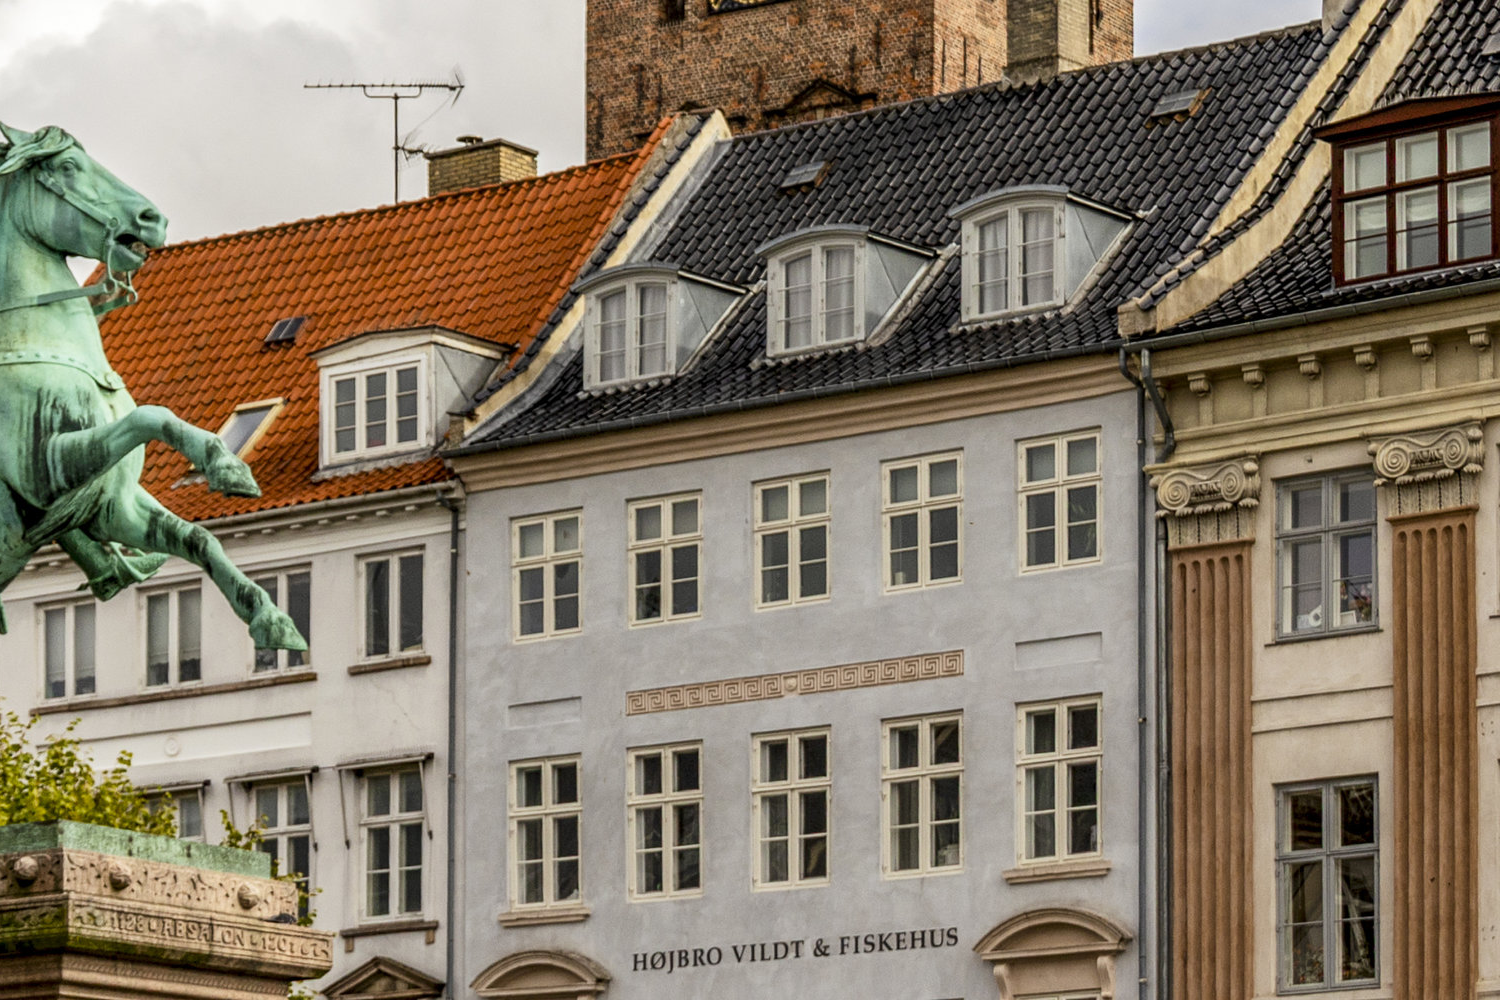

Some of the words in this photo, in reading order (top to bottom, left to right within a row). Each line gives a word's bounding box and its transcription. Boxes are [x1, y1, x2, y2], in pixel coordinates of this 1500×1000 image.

[110, 911, 144, 932] 1128
[161, 917, 245, 946] ABSALON
[632, 946, 723, 975] HØJBRO
[732, 939, 805, 964] VILDT
[813, 938, 831, 958] &
[839, 926, 959, 956] FISKEHUS
